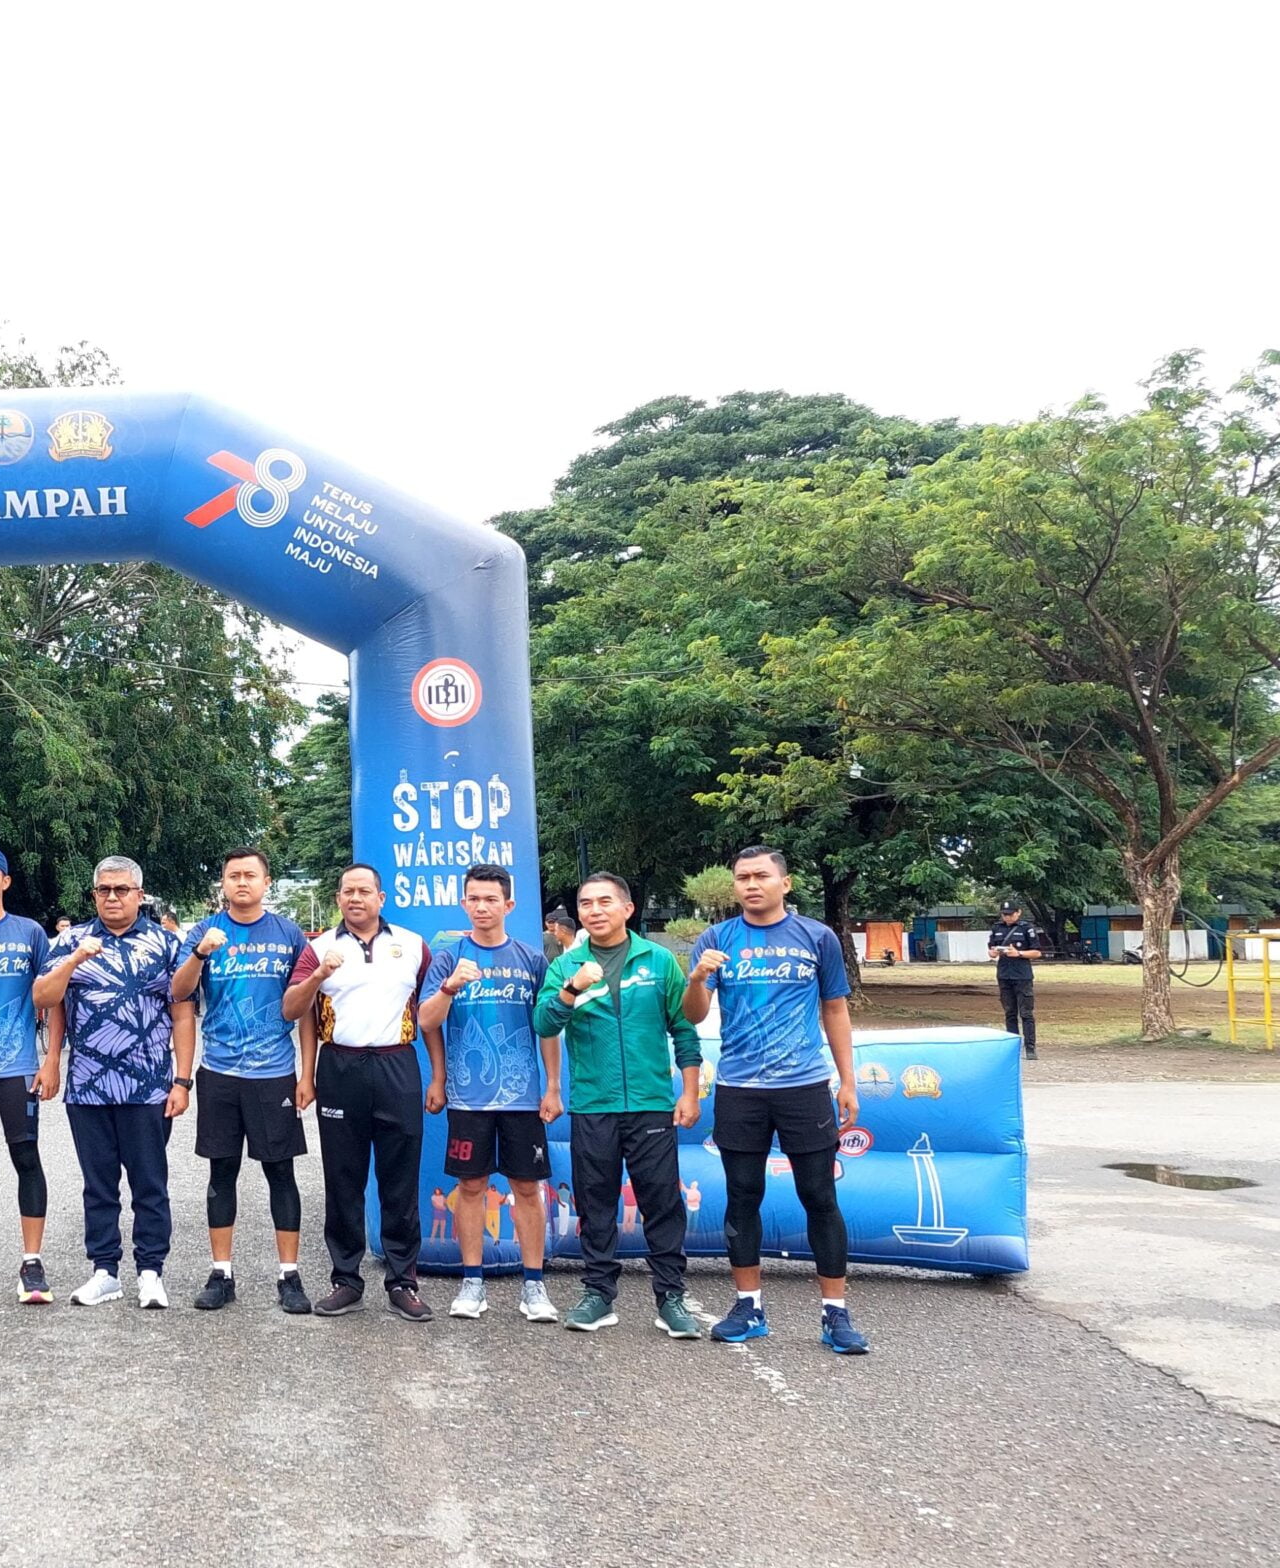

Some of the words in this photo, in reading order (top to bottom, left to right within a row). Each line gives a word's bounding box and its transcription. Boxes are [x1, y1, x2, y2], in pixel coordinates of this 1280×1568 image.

[310, 494, 379, 535] MELAJU
[323, 482, 374, 515] TERUS
[303, 510, 359, 547] UNTUK
[285, 543, 333, 573] MAJU
[293, 526, 380, 579] INDONESIA
[392, 774, 511, 832] STOP
[393, 833, 513, 868] WARISKAN
[448, 1138, 473, 1161] 28
